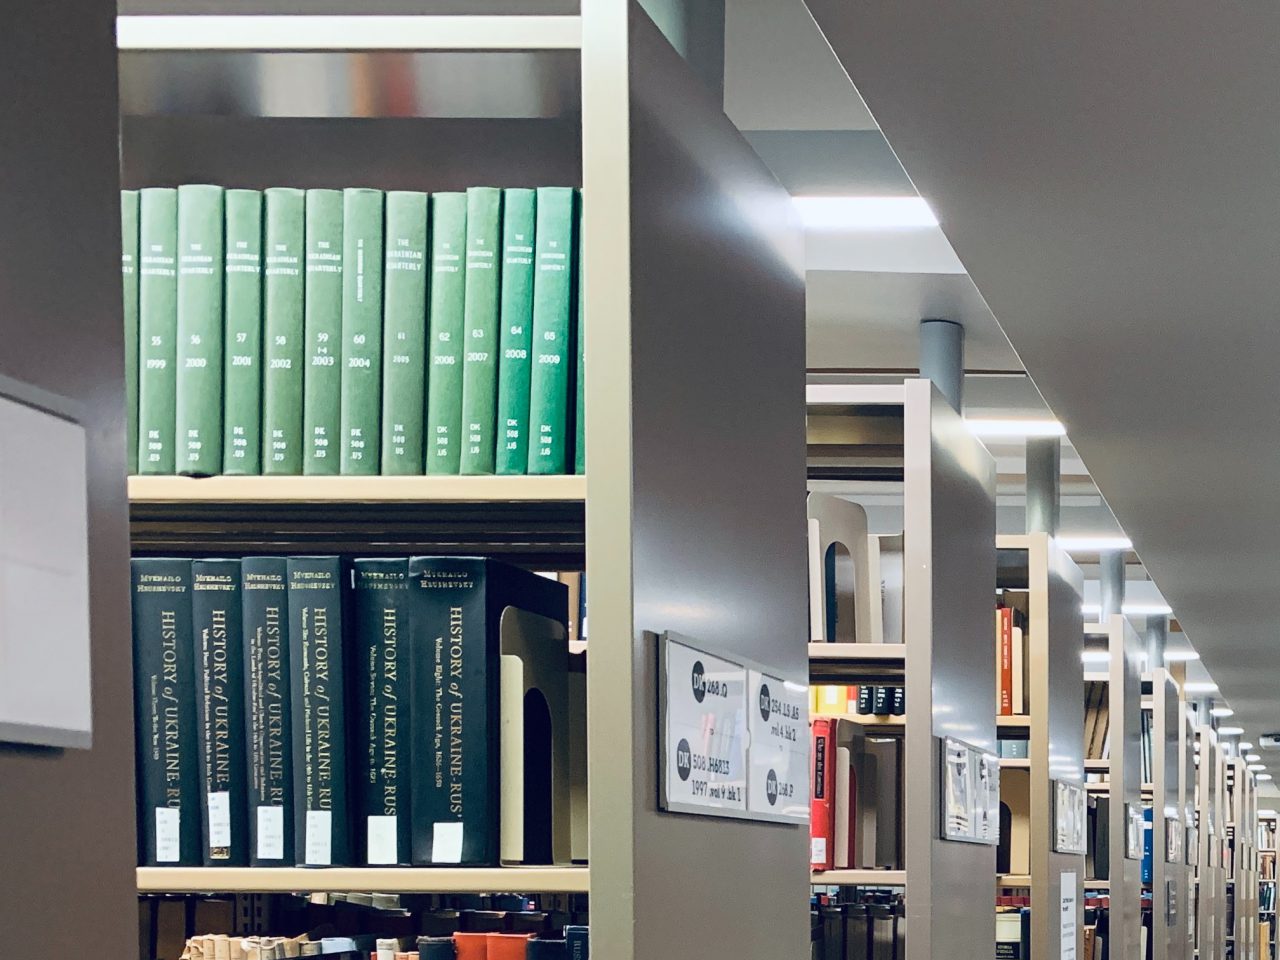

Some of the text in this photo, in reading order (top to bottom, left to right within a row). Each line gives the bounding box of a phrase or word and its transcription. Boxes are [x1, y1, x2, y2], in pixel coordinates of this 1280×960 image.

[472, 329, 484, 338] 63
[510, 326, 522, 335] 64
[151, 335, 162, 346] 55
[190, 334, 201, 345] 56
[236, 332, 247, 342] 57
[275, 335, 286, 345] 58
[317, 332, 329, 342] 59
[353, 334, 366, 344] 60
[439, 332, 450, 342] 62
[544, 331, 556, 341] 65
[467, 353, 488, 362] 2007
[505, 349, 527, 359] 2008
[146, 359, 167, 369] 1999
[185, 358, 207, 368] 2000
[232, 356, 251, 366] 2001
[269, 359, 292, 369] 2002
[311, 356, 334, 366] 2003
[348, 358, 371, 368] 2004
[434, 356, 455, 365] 2006
[538, 355, 561, 364] 2009
[233, 426, 244, 435] DK
[161, 611, 178, 684] HISTORY
[314, 608, 329, 683] HISTORY
[383, 608, 397, 681] HISTORY
[450, 606, 463, 680] HISTORY
[693, 673, 706, 691] DK
[164, 686, 178, 703] of
[315, 685, 330, 702] of
[384, 684, 397, 701] of
[449, 682, 463, 698] of
[678, 750, 690, 769] DK
[691, 779, 708, 797] 1997
